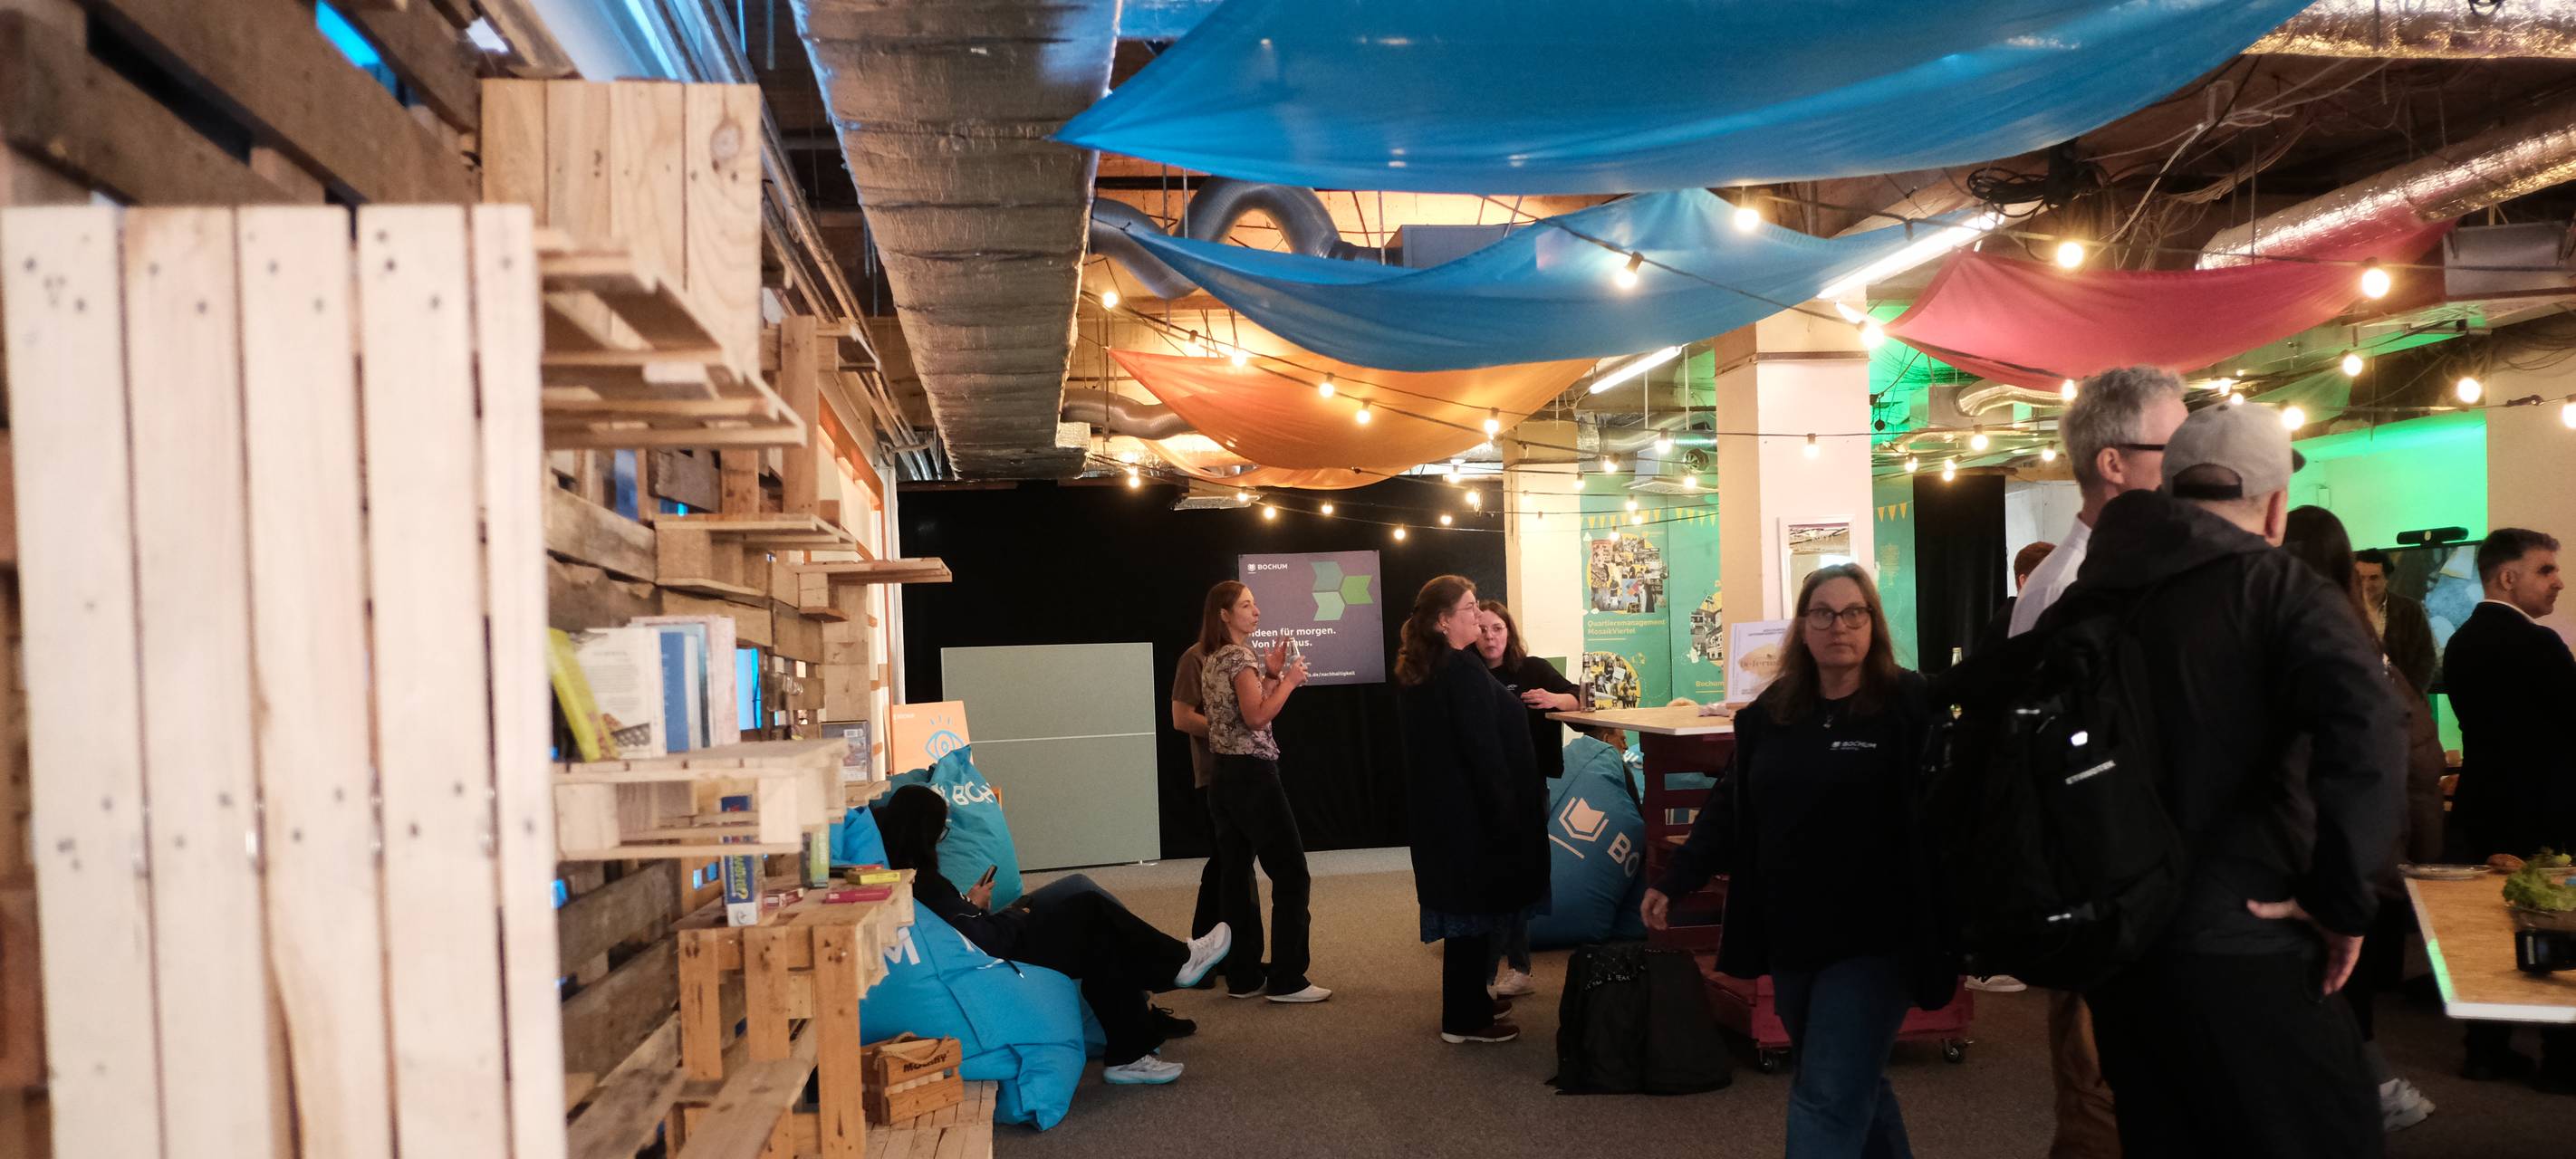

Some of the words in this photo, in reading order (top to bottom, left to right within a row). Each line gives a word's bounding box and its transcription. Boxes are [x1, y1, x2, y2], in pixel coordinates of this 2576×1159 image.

[1280, 627, 1293, 636] für
[1296, 627, 1337, 637] morgen.
[1252, 640, 1270, 648] Von
[1272, 639, 1291, 647] hr
